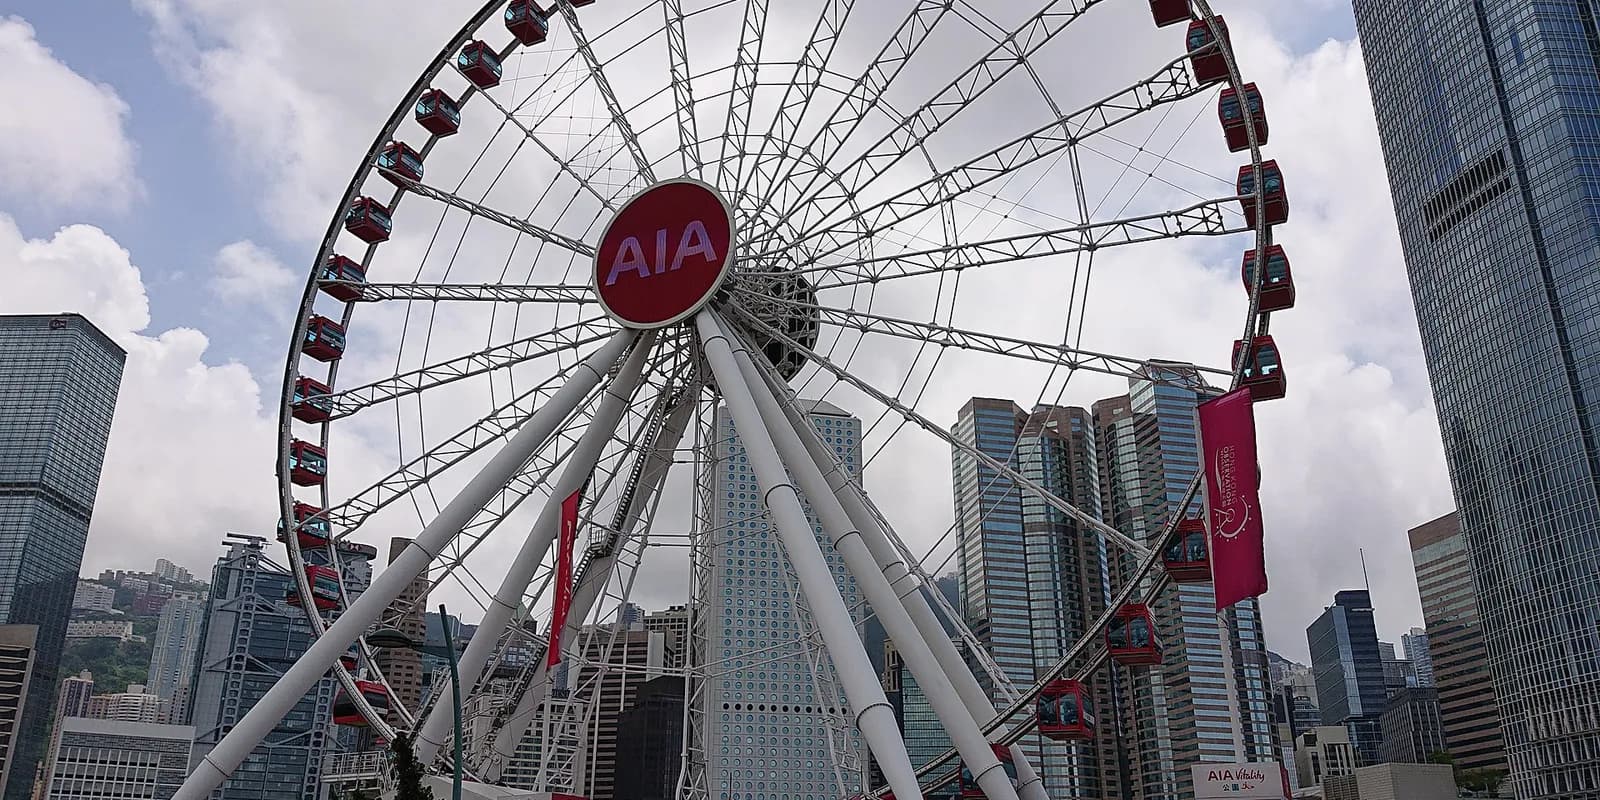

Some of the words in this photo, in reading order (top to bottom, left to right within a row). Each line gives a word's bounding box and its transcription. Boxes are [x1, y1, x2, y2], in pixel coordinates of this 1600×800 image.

[604, 220, 718, 286] AIA
[1223, 446, 1231, 505] OBSERVATION
[1208, 770, 1234, 781] AIA
[1236, 768, 1264, 783] Vitality
